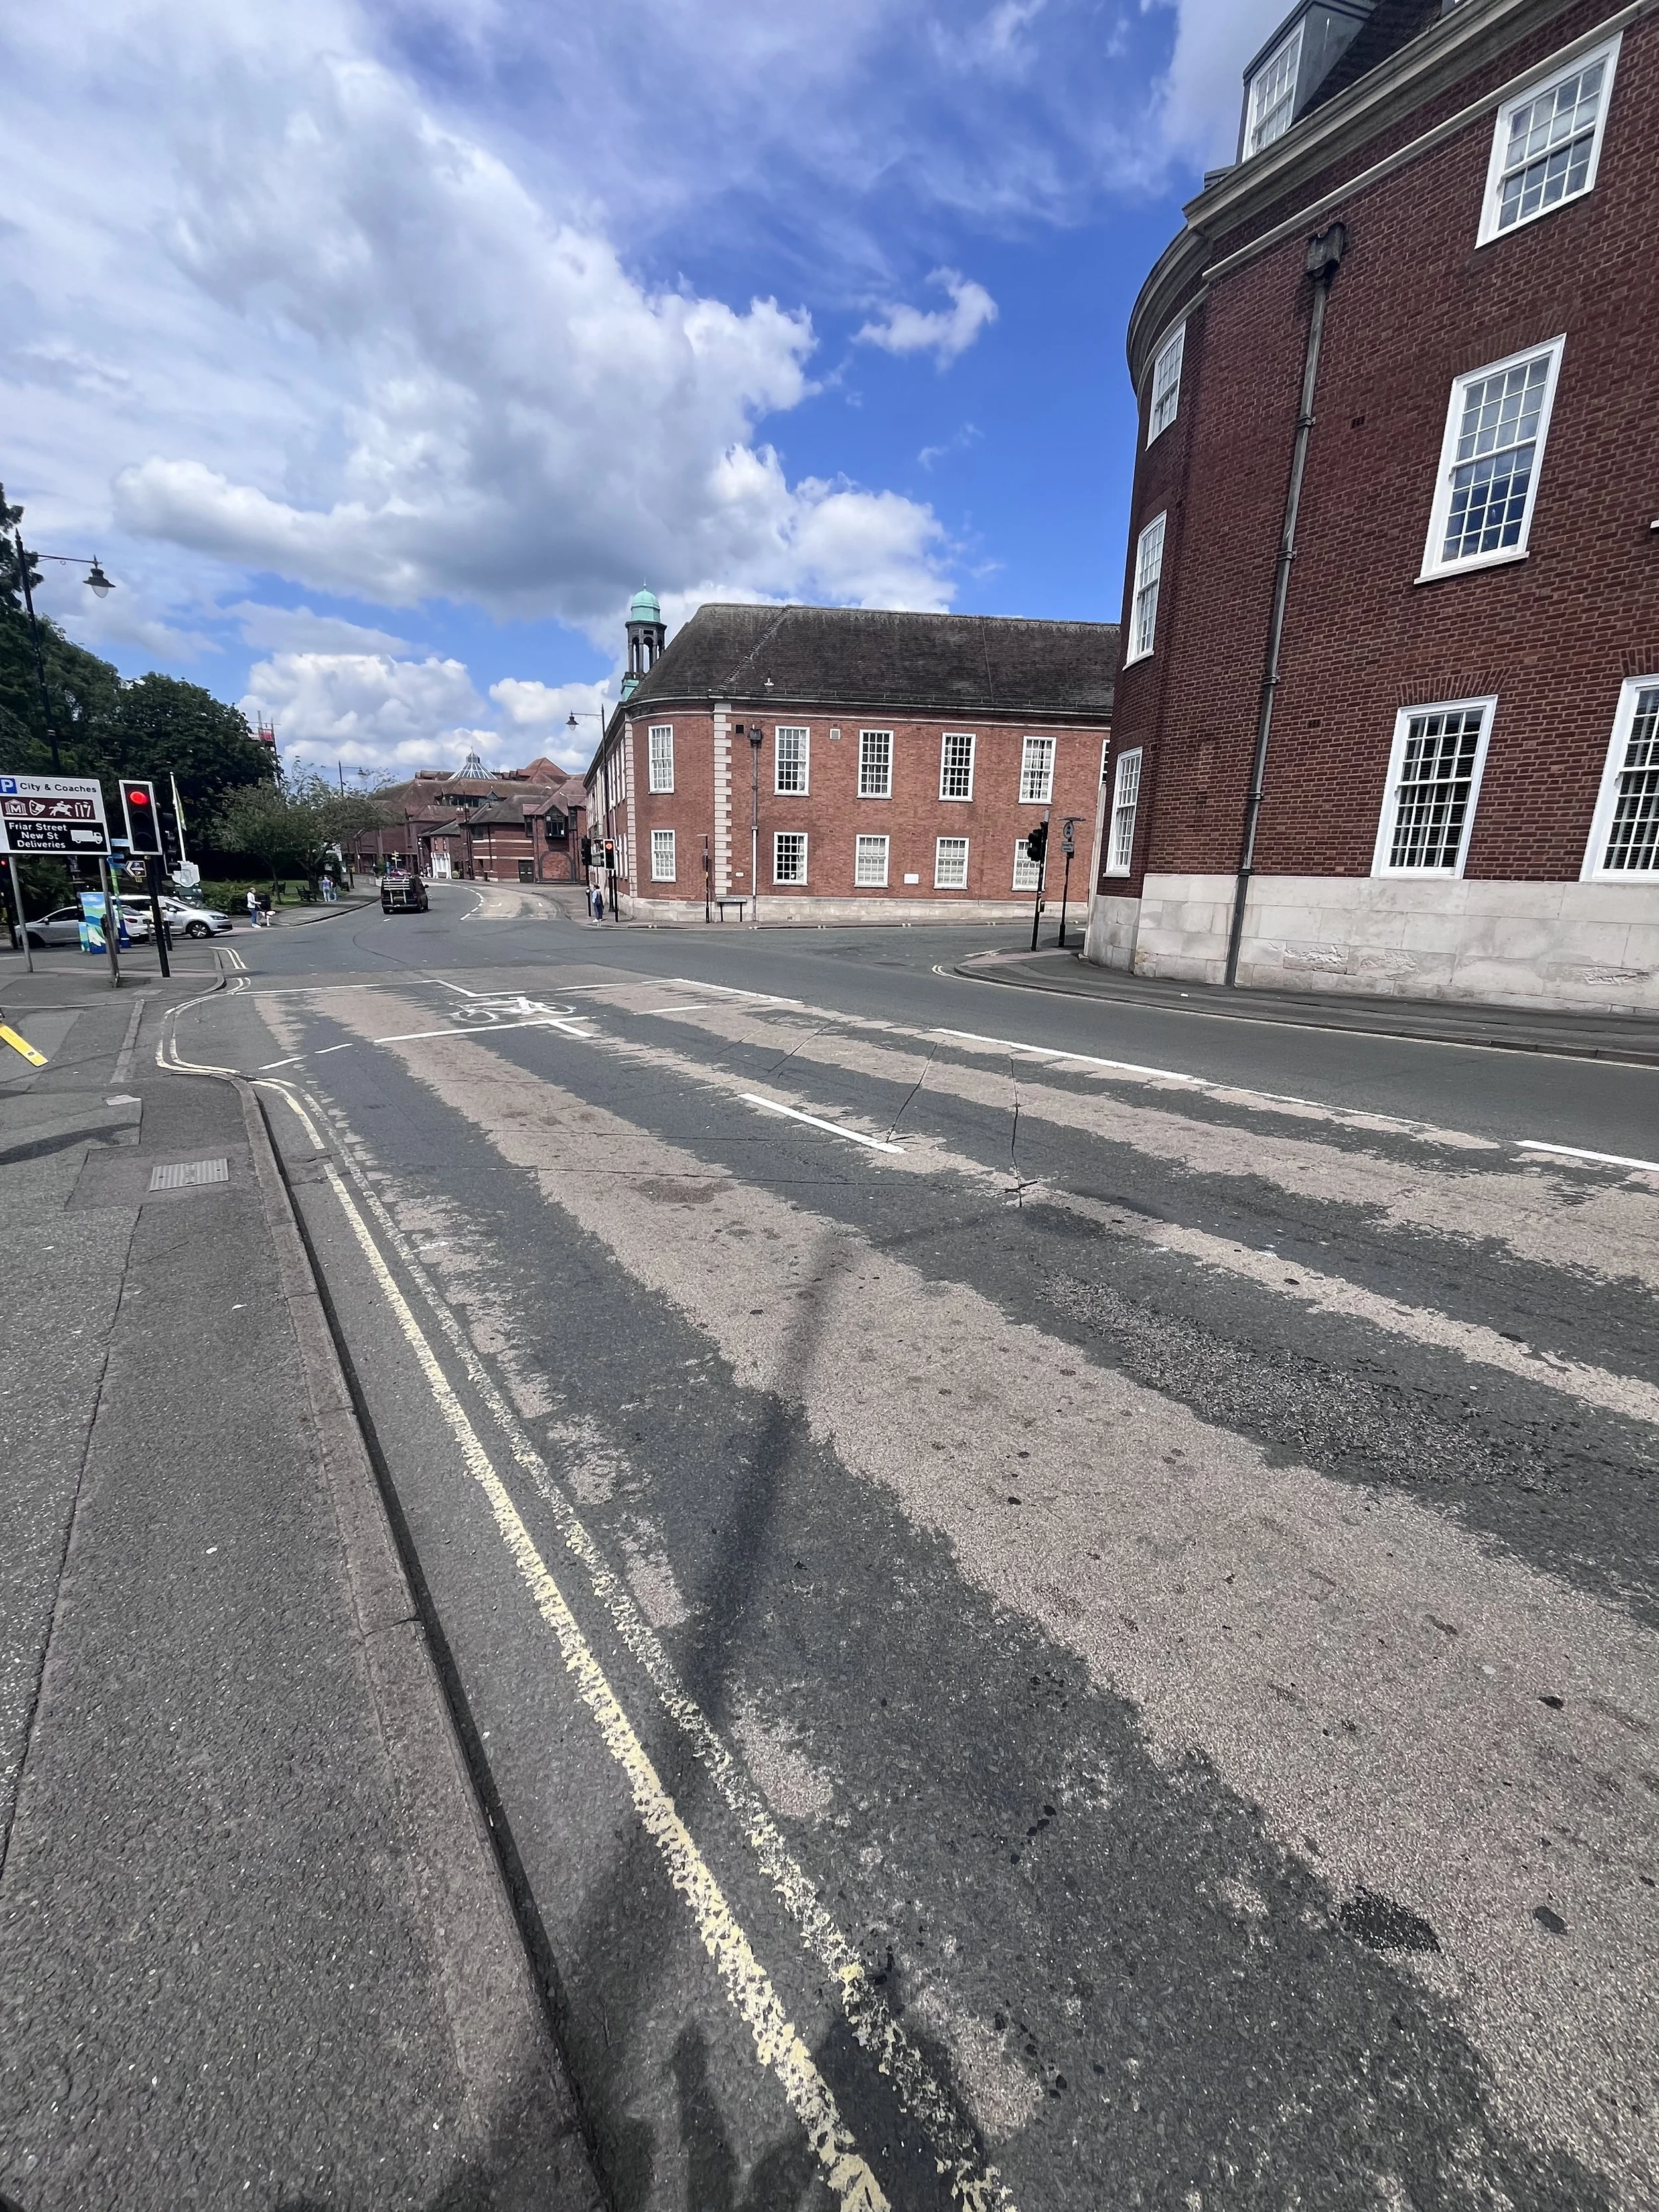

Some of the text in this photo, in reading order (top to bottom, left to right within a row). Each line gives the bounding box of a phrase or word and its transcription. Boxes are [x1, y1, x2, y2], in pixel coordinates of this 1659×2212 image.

[1, 778, 14, 792] P
[20, 782, 40, 792] City
[54, 784, 97, 793] Coaches
[35, 823, 68, 832] Street
[17, 840, 66, 848] Deliveries
